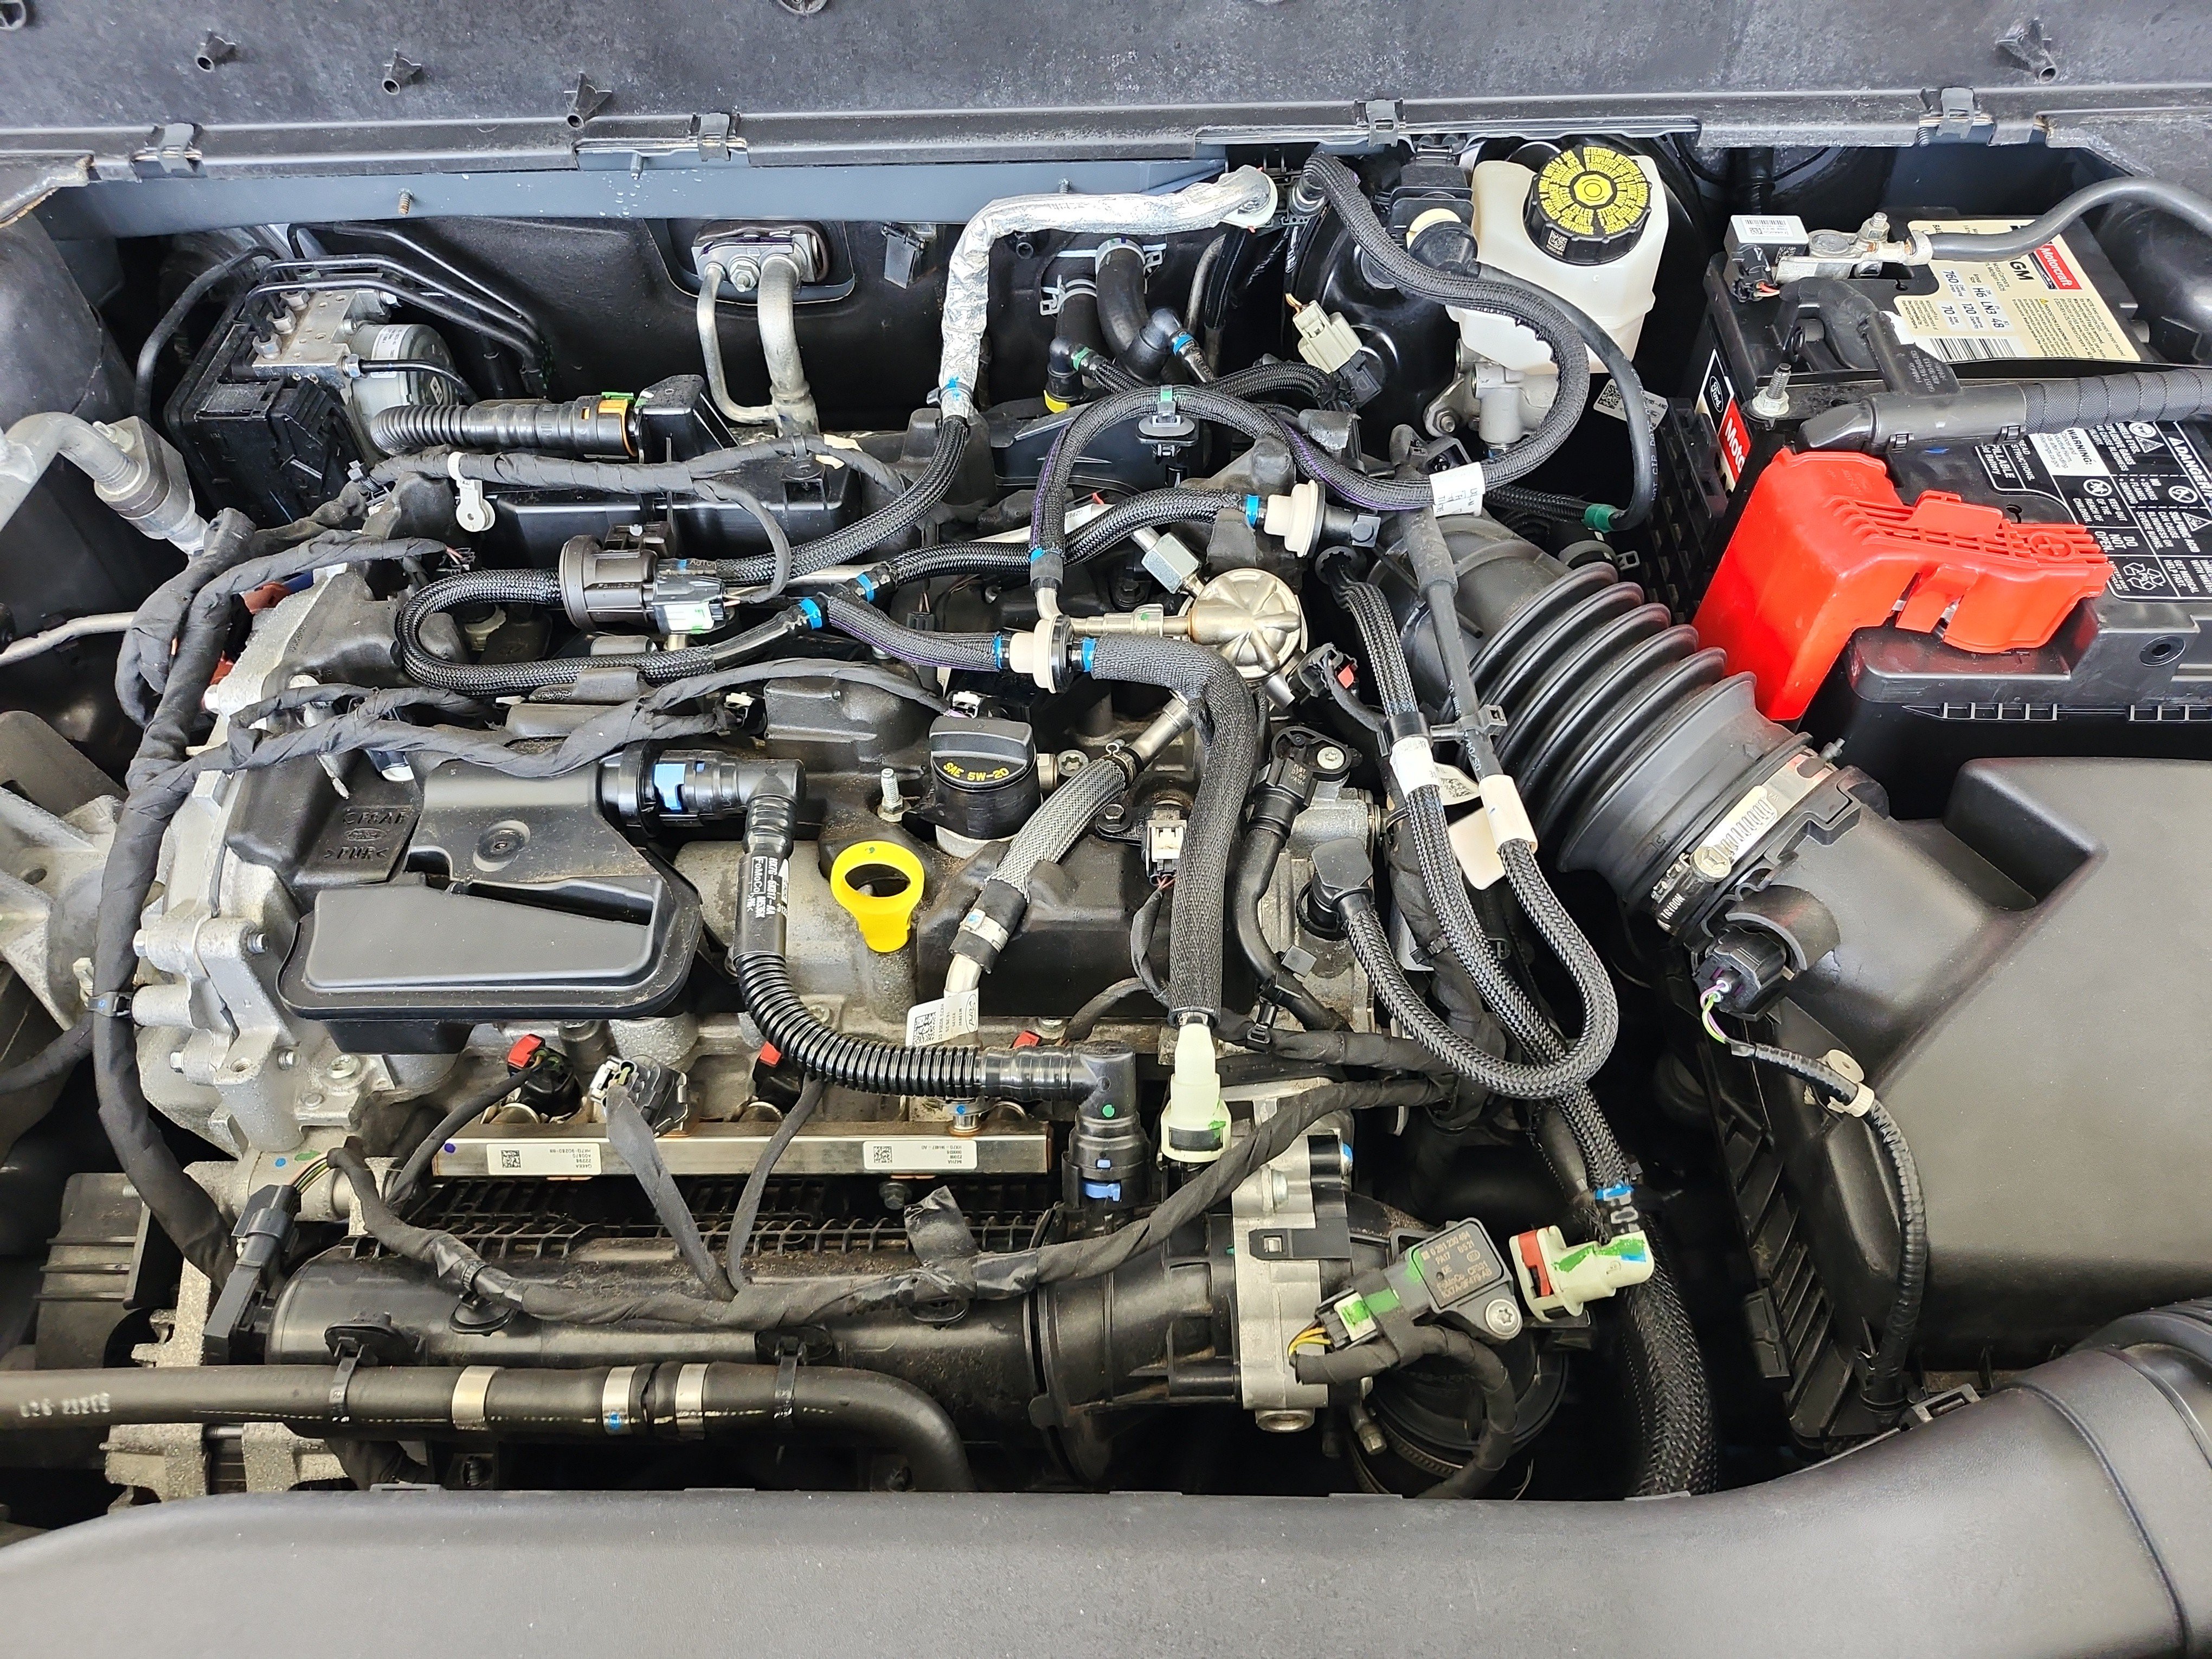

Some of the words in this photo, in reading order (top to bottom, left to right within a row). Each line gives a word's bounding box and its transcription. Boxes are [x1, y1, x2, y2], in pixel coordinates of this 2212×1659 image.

[1561, 150, 1575, 160] DOT
[1584, 147, 1616, 158] ATTENTION
[1542, 161, 1559, 176] FLUID
[1567, 158, 1580, 168] CAP
[1615, 154, 1641, 175] NETTOYER
[1616, 165, 1628, 176] QUE
[1550, 164, 1568, 184] BEFORE
[1559, 165, 1585, 185] WARNING
[1634, 175, 1645, 183] LE
[1539, 177, 1549, 192] FROM
[1586, 163, 1620, 179] PROVENANT
[1613, 191, 1626, 207] BIDON
[1549, 184, 1565, 210] REMOVING
[1559, 187, 1574, 207] CLEAN
[1636, 183, 1648, 207] BOUCHON
[1541, 200, 1561, 219] SEALED
[1561, 208, 1576, 220] USE
[1570, 203, 1594, 217] FILLER
[1615, 205, 1632, 218] FREIN
[1626, 207, 1643, 224] AVANT
[1558, 218, 1593, 235] CONTAINER
[1574, 216, 1593, 226] ONLY
[1599, 218, 1605, 227] 4
[1605, 215, 1617, 225] DOT
[2008, 261, 2035, 280] GM
[2039, 248, 2074, 286] Motorcraft
[1942, 271, 1960, 282] 760
[1972, 274, 1983, 282] Group
[1940, 306, 1956, 314] 70
[1960, 303, 1977, 313] 120
[1972, 288, 1988, 297] H6
[1980, 301, 1998, 314] LN3
[1989, 318, 2005, 327] 48
[2081, 303, 2092, 314] warranty
[2068, 303, 2080, 317] complete
[2078, 318, 2088, 330] warranty
[2114, 344, 2125, 356] required
[2114, 422, 2133, 439] SHIELD
[2066, 429, 2094, 464] WARNING:
[2099, 432, 2114, 446] CAUSE
[2107, 447, 2129, 471] BLINDNESS
[1984, 454, 2001, 474] Battery
[2118, 449, 2136, 464] GASES
[2118, 482, 2139, 503] SMOKING
[2129, 482, 2147, 500] FLAMES
[2139, 482, 2158, 500] SPARKS
[2072, 498, 2093, 523] CHILDREN.
[2084, 498, 2100, 514] REACH
[2100, 506, 2112, 515] THE
[2107, 498, 2121, 510] KEEP
[2114, 511, 2127, 521] OUT
[2145, 511, 2170, 538] BLINDNESS
[2157, 511, 2171, 522] CAN
[2135, 511, 2154, 530] SEVERE
[2146, 531, 2165, 549] BURNS.
[2163, 523, 2181, 538] CAUSE
[2167, 511, 2191, 537] SULFURIC
[2183, 539, 2201, 552] ACID
[2094, 531, 2115, 552] OPEN.
[2108, 534, 2126, 548] NOT
[2122, 536, 2139, 546] DO
[2173, 560, 2186, 569] GET
[2189, 560, 2204, 573] WITH
[2163, 560, 2178, 573] HELP
[2171, 574, 2186, 587] FAST.
[2179, 571, 2200, 593] MEDICAL
[2118, 580, 2130, 591] MUST
[943, 762, 964, 778] SAE
[967, 767, 1009, 781] 5W-20
[753, 858, 764, 893] FoMoCo
[1660, 893, 1686, 919] TRIDON
